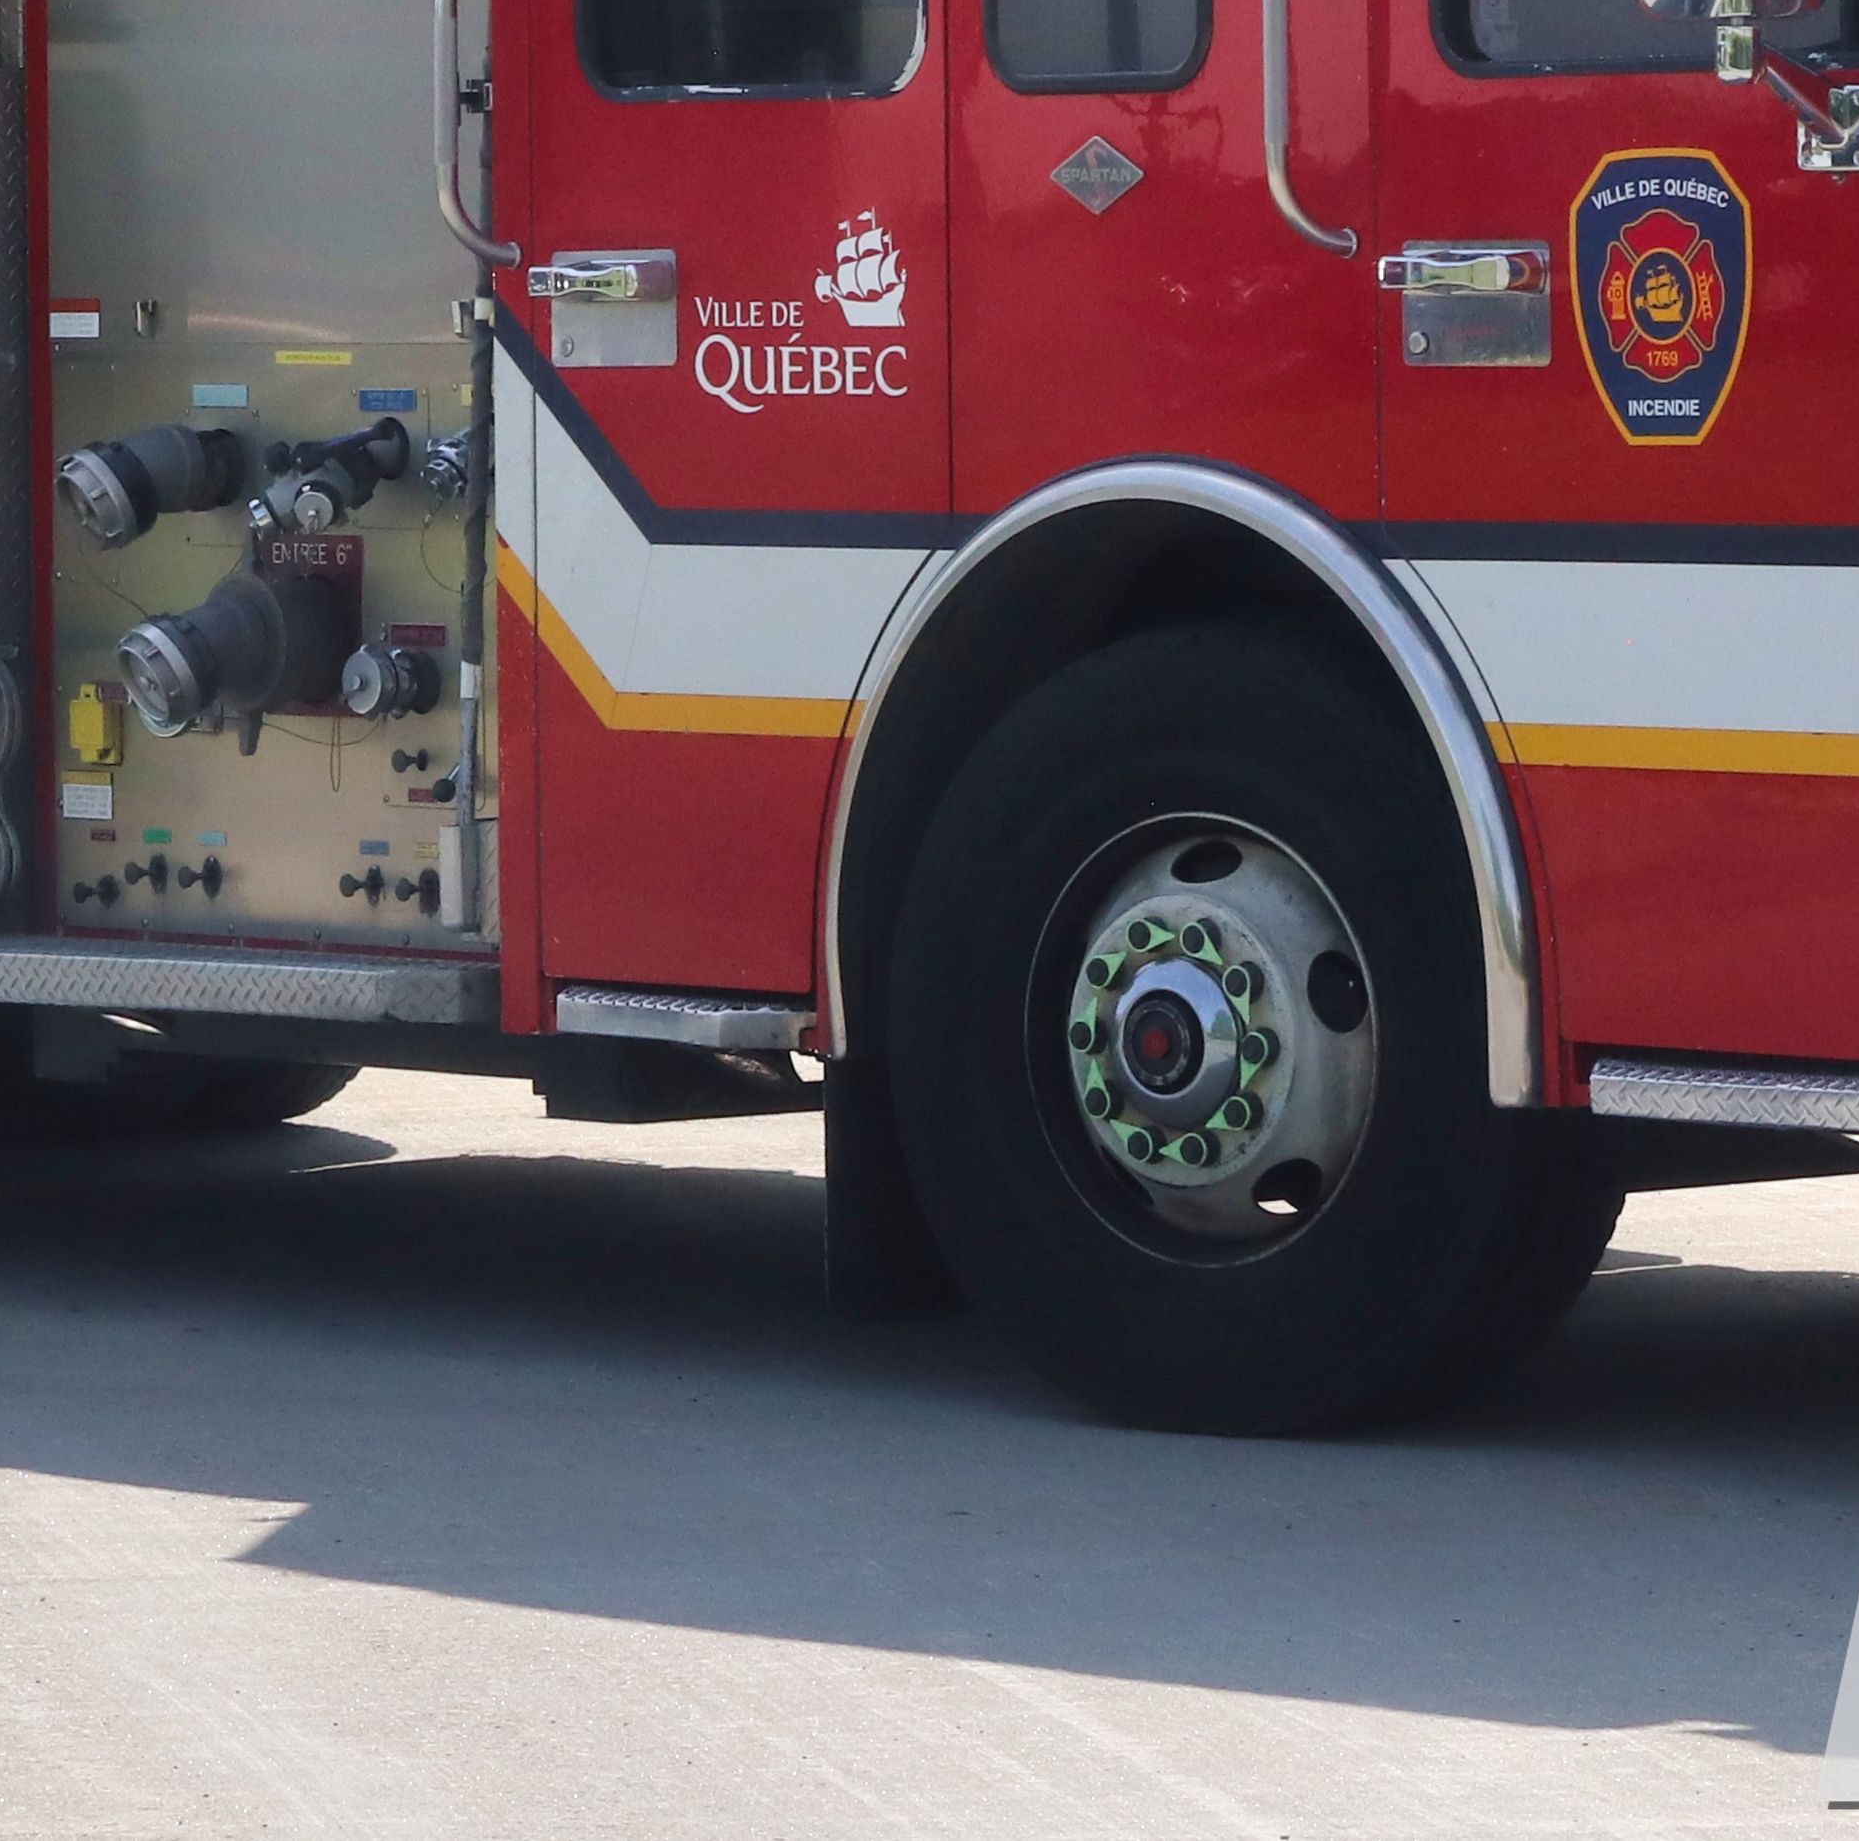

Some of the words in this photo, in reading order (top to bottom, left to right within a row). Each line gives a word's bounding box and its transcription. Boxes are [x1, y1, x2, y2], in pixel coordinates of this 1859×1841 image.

[1060, 166, 1131, 183] SPARTAN
[1591, 181, 1637, 210] VILLE
[1638, 178, 1661, 197] DE
[1663, 177, 1730, 208] QUÉBEC
[771, 300, 805, 327] DE
[1646, 350, 1679, 367] 1769
[1627, 399, 1701, 417] INCENDIE
